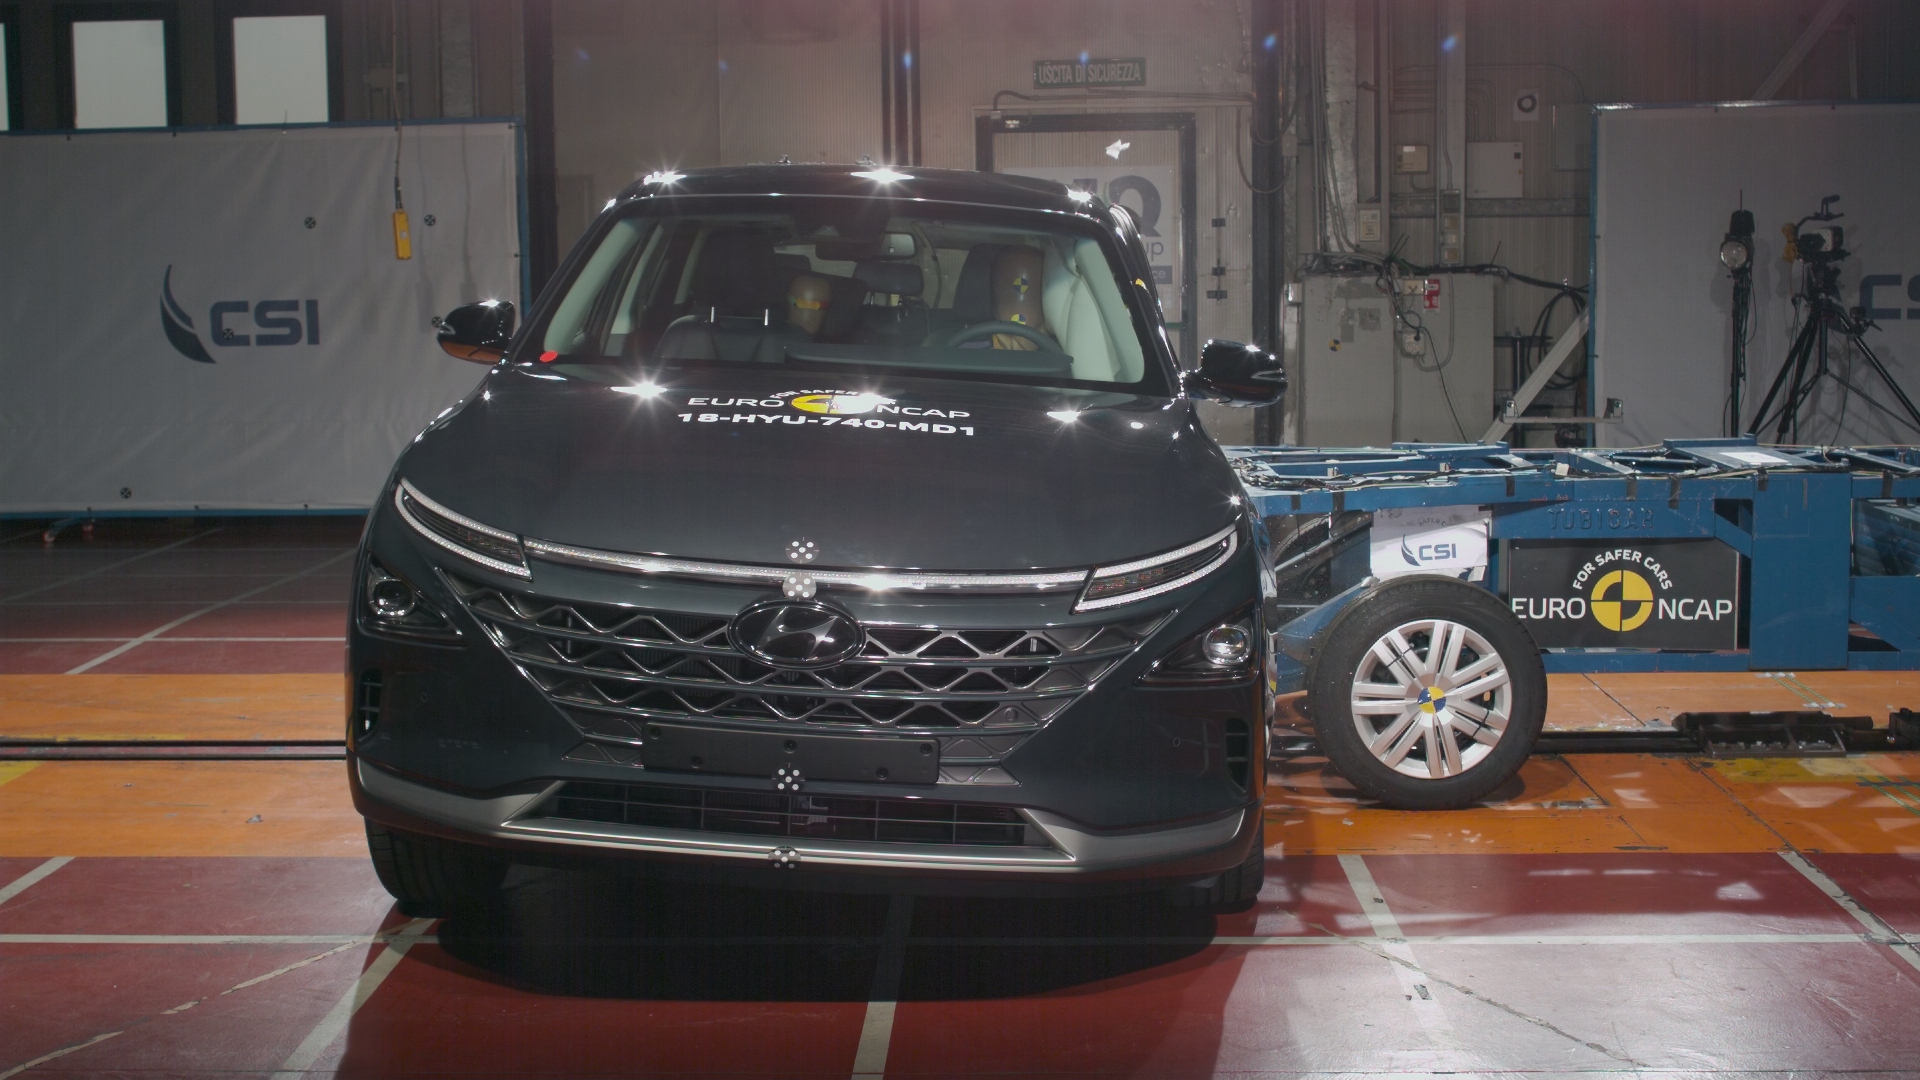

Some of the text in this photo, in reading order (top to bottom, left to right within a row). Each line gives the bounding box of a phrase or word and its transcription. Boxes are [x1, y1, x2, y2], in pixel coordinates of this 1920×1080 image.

[1038, 62, 1142, 83] USCITA DI SICUREZZA
[209, 299, 320, 347] CSI
[769, 388, 859, 400] FOR SAFER
[687, 396, 971, 419] EURO NCAP
[677, 412, 975, 437] 18-HYU-740-MD1
[1418, 543, 1458, 561] CSI
[1572, 549, 1674, 590] FOR SAFER CARS
[1511, 597, 1733, 621] EURO NCAP
